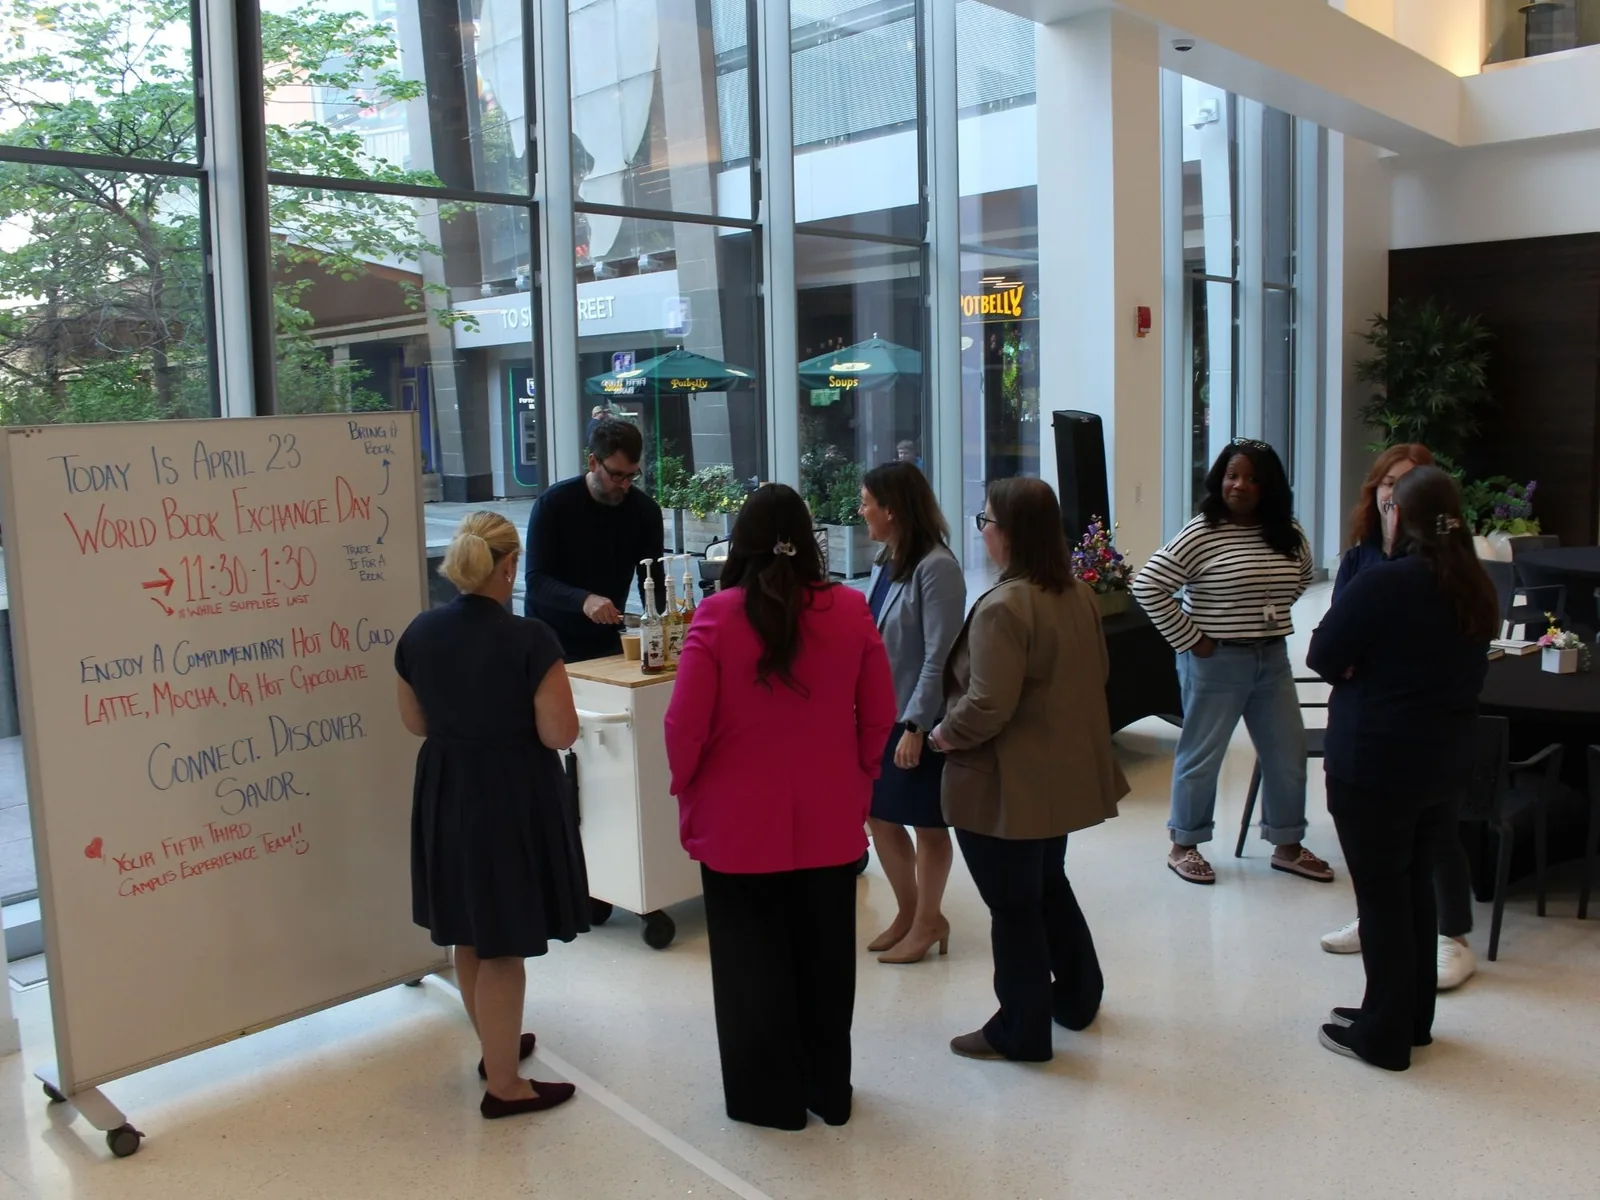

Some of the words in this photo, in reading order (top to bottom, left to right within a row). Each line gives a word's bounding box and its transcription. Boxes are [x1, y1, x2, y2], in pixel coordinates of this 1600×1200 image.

[500, 308, 518, 329] TO
[578, 296, 615, 320] REET
[961, 285, 1024, 317] OTBELLY
[671, 377, 708, 391] Potbelly
[829, 375, 859, 391] Soups
[347, 420, 387, 440] BRING
[47, 454, 131, 493] TODAY
[151, 446, 179, 485] IS
[193, 440, 255, 480] APRIL
[266, 433, 301, 471] 23
[363, 440, 396, 455] BOOK
[63, 503, 157, 555] WORLD
[162, 497, 226, 541] BOOK
[232, 486, 331, 534] EXCHANGE
[335, 475, 371, 523] DAY
[342, 544, 373, 555] TRADE
[361, 557, 377, 568] FOR
[378, 553, 386, 566] A
[359, 570, 386, 581] BOOK
[230, 599, 280, 613] SUPPLIES
[286, 594, 310, 606] LAST
[80, 655, 144, 684] ENJOY
[153, 643, 165, 674] A
[173, 637, 285, 676] COMPLIMENTARY
[292, 626, 322, 659] HOT
[330, 620, 351, 651] OR
[356, 617, 395, 652] COLD
[84, 693, 150, 726] LATTE,
[228, 673, 254, 706] OR
[256, 672, 286, 702] HOT
[290, 664, 369, 694] CHOCOLATE
[148, 736, 261, 791] CONNECT.
[215, 771, 311, 816] SAVOR.
[112, 850, 156, 875] YOUR
[161, 836, 205, 859] FIFTH
[204, 821, 252, 845] THIRD
[117, 867, 178, 897] CAMPUS
[179, 846, 259, 880] EXPERIENCE
